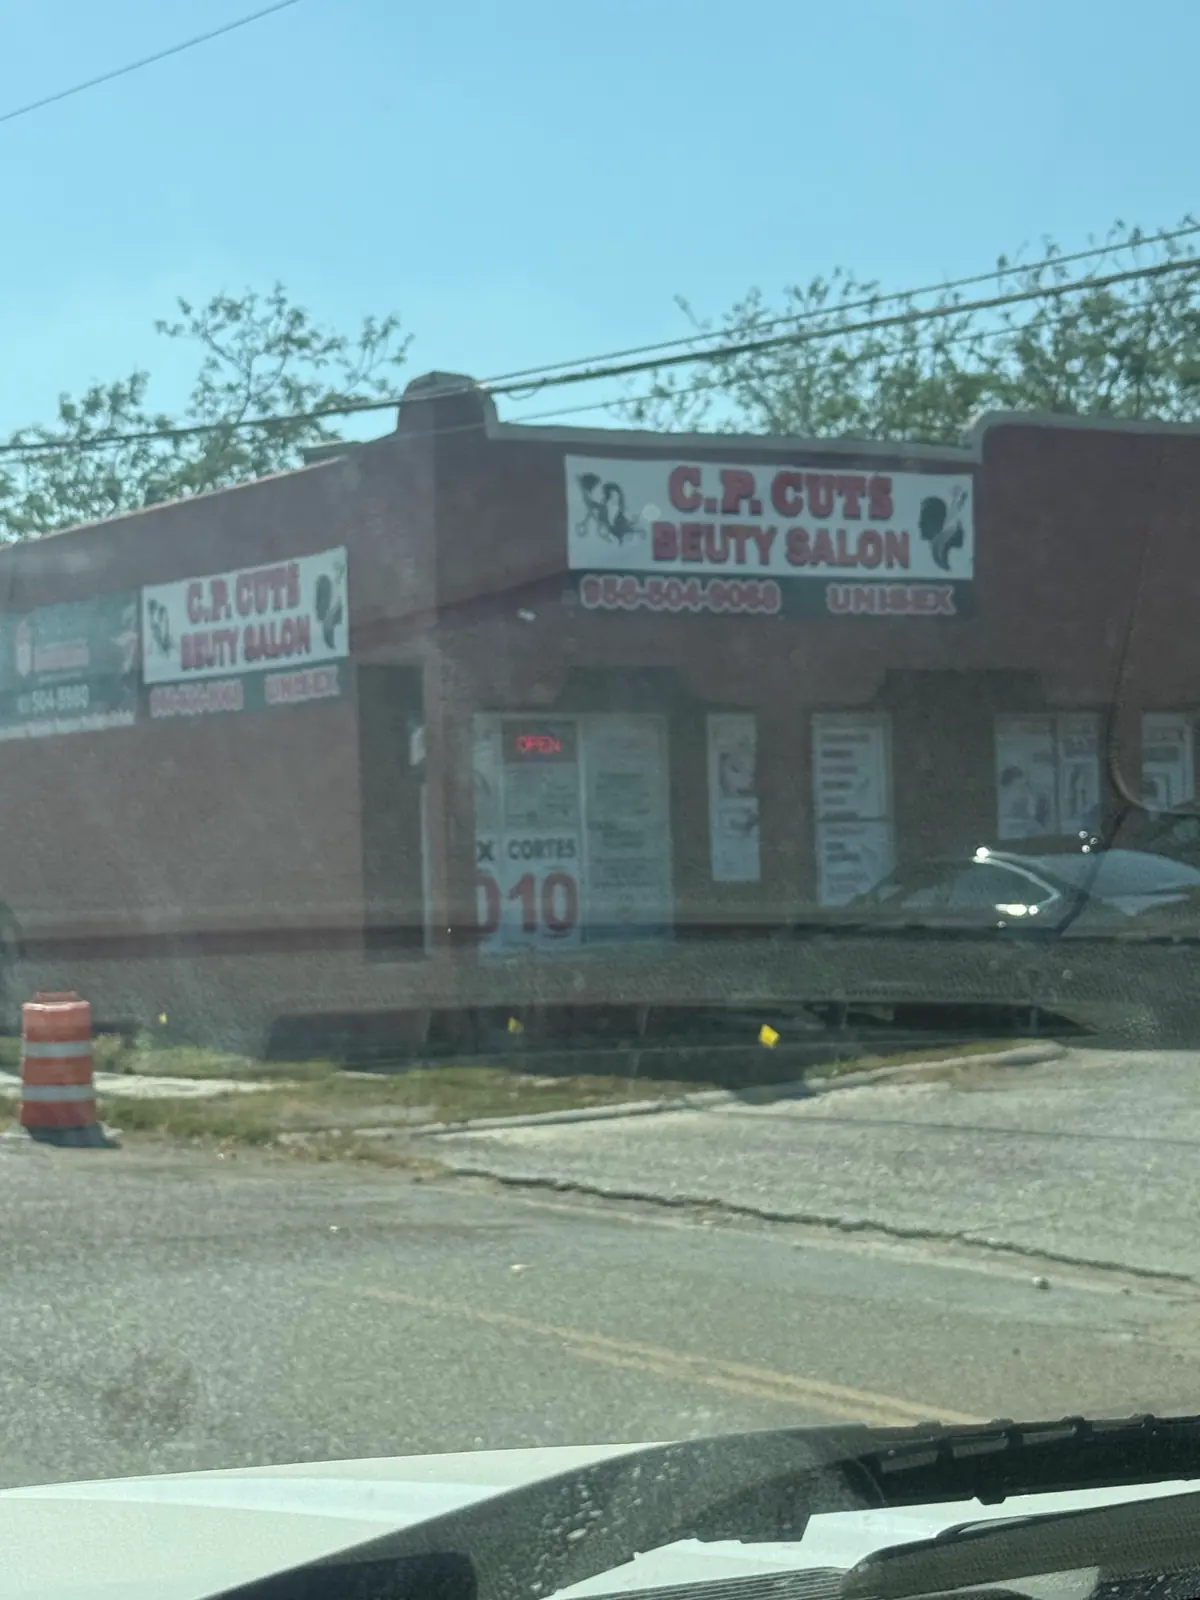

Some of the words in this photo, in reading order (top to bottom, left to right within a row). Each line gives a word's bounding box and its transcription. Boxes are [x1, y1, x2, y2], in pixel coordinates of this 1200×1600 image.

[771, 469, 894, 521] CUTS
[652, 521, 778, 566] BEUTY
[785, 527, 911, 569] SALON
[236, 562, 299, 616] CUTS
[827, 581, 956, 615] UNISEX
[244, 614, 312, 664] SALON
[516, 735, 562, 754] OPEN
[508, 838, 577, 861] CORTES
